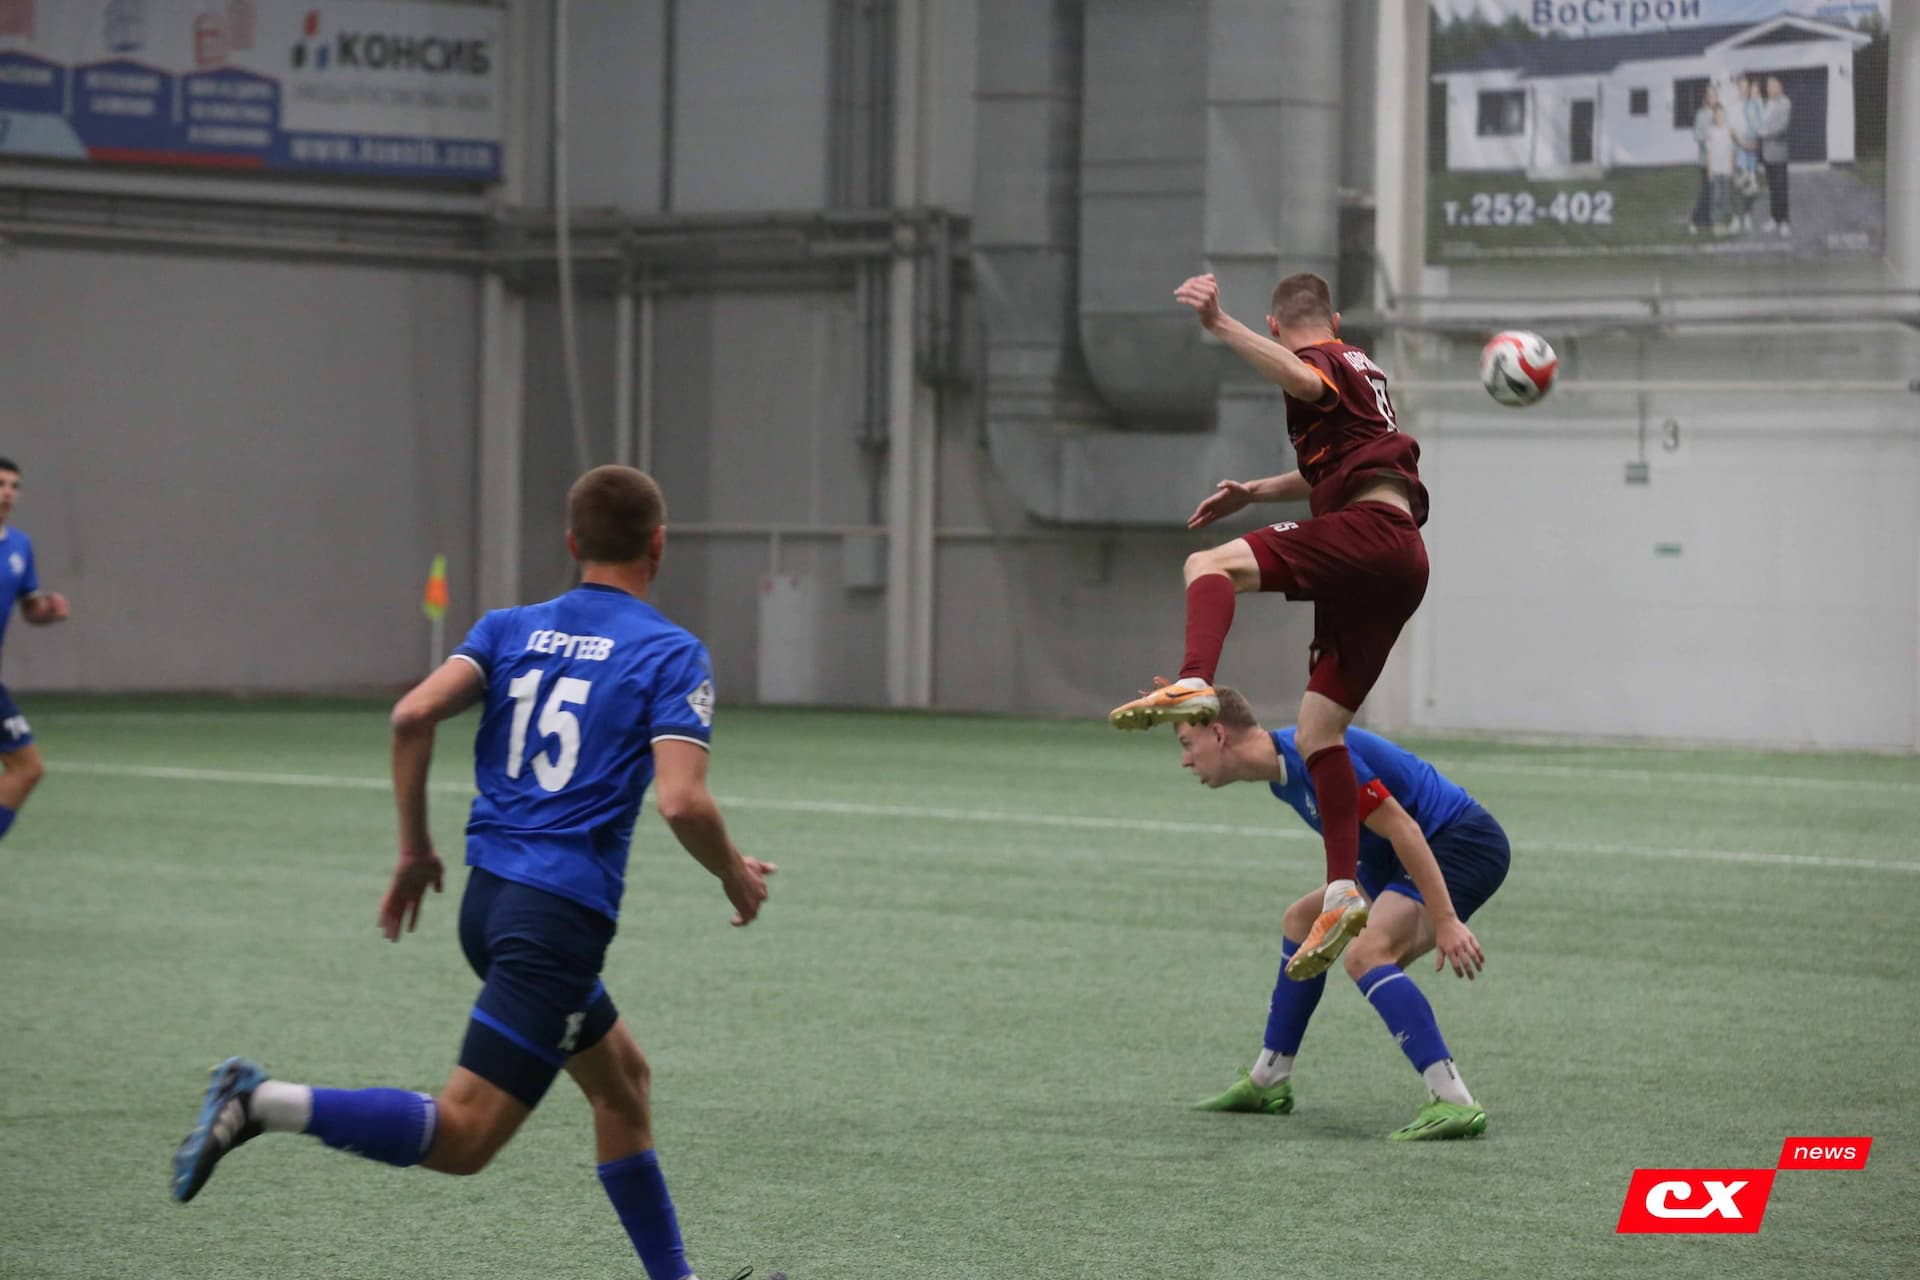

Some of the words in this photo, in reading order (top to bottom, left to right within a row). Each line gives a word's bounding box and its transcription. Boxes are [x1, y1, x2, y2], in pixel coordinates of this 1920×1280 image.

[336, 33, 491, 78] КОНСИБ
[1662, 418, 1680, 454] 3
[506, 668, 593, 792] 15
